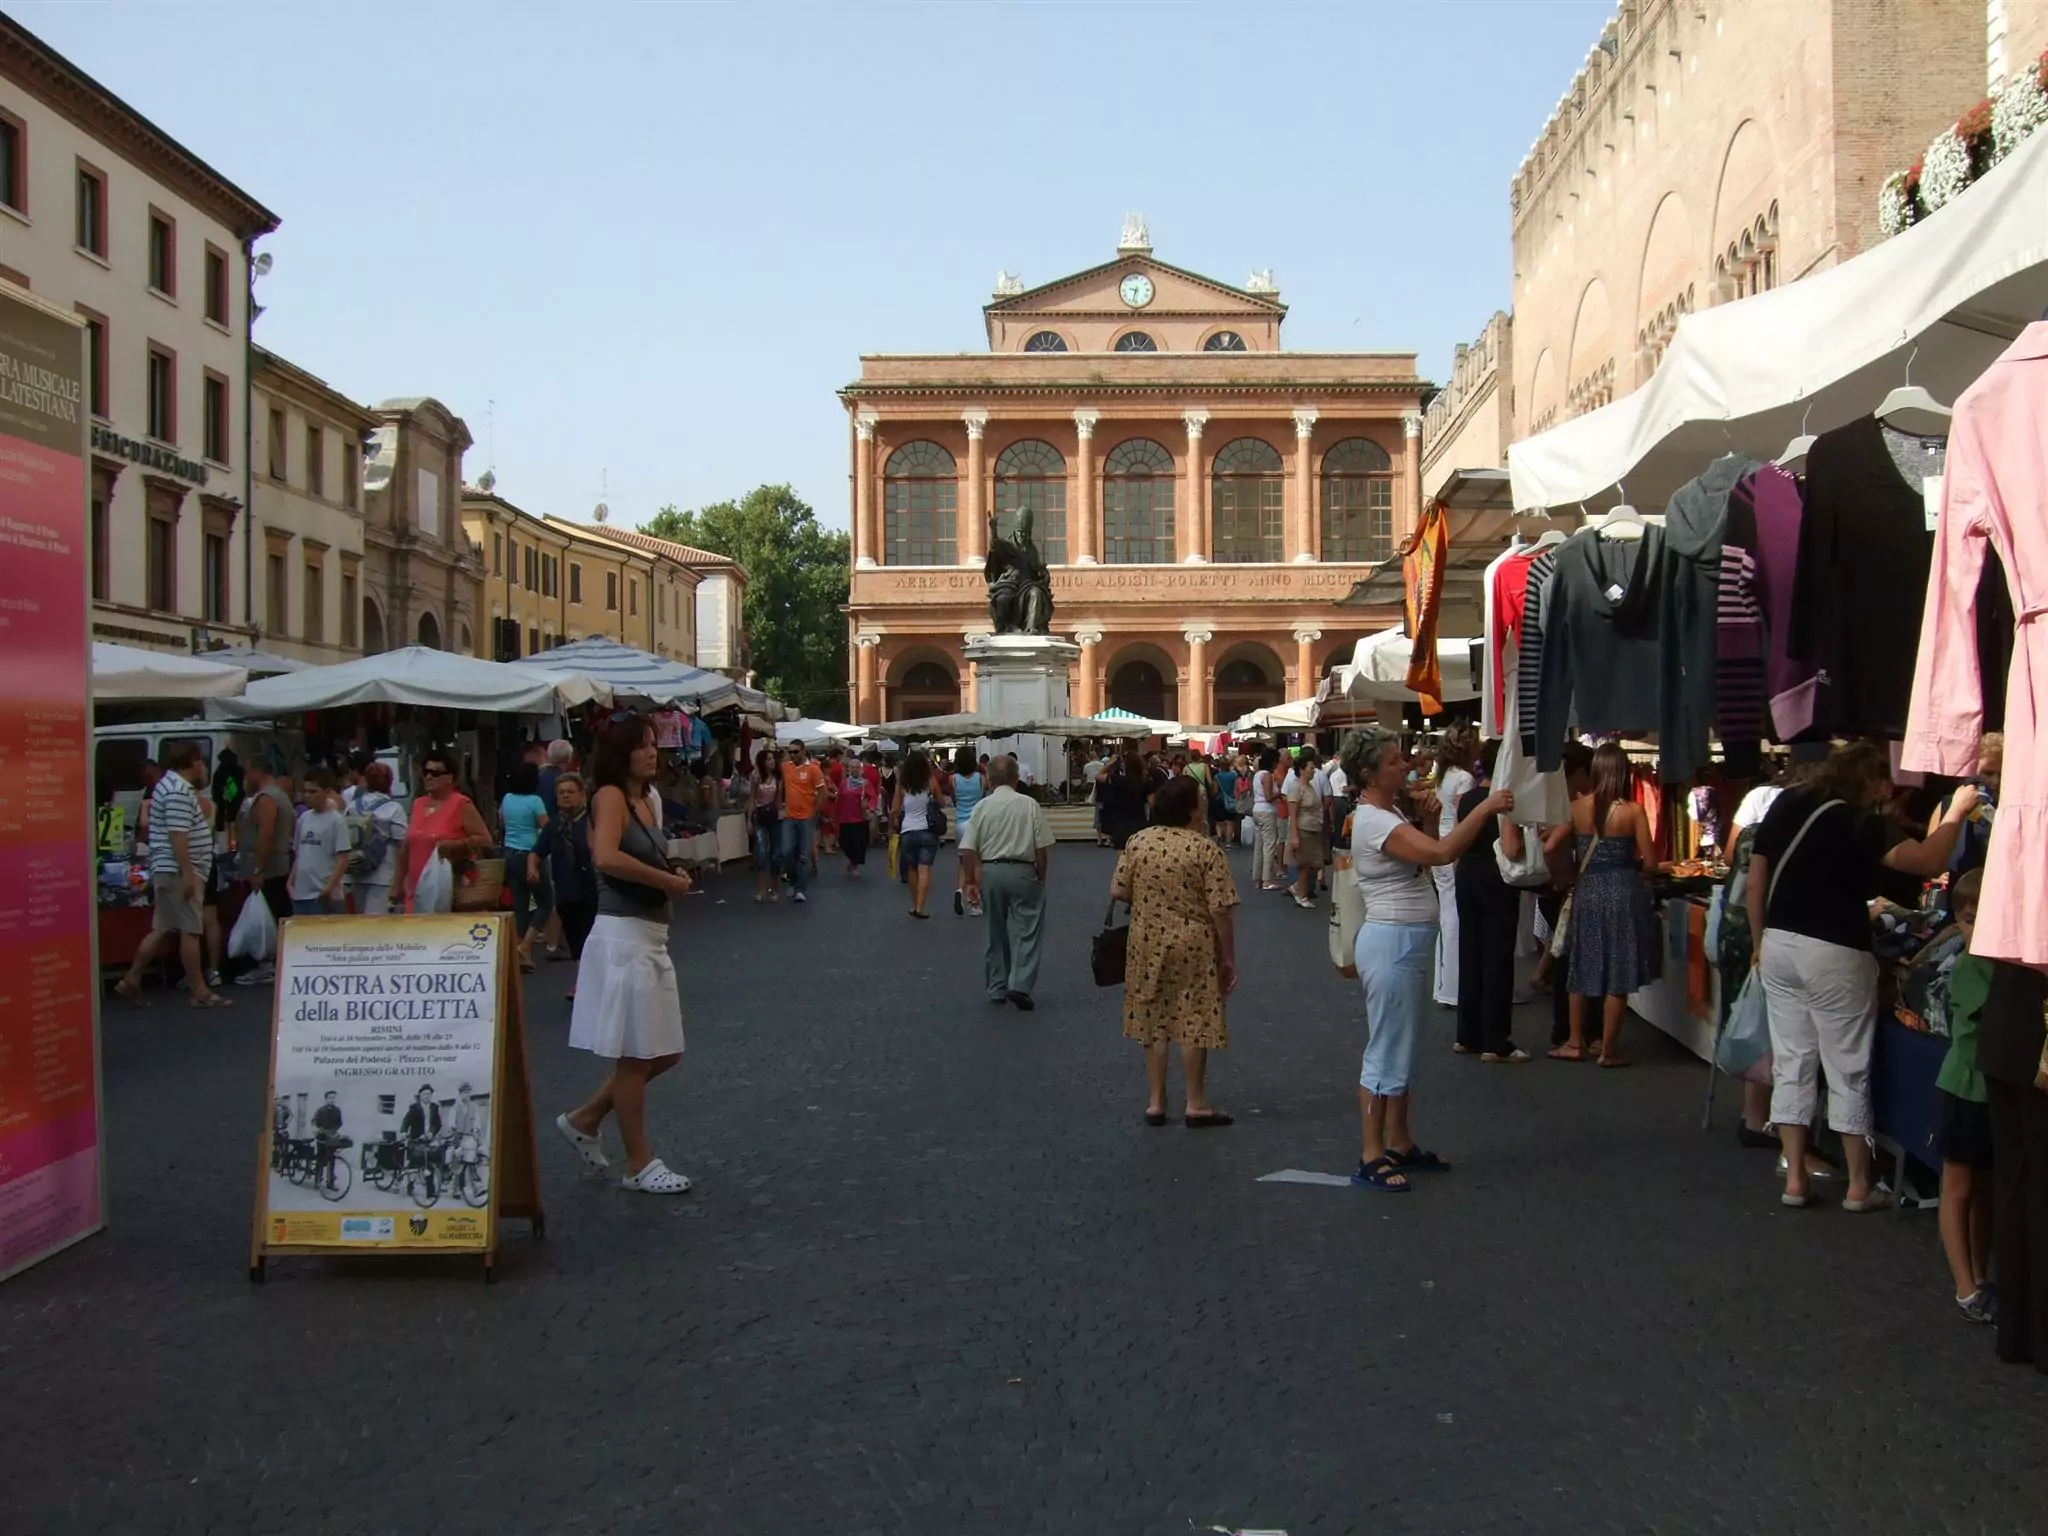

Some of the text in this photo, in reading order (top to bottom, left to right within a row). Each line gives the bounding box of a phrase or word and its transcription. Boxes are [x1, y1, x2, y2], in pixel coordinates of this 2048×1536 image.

[23, 362, 80, 403] MUSICALE
[897, 575, 937, 588] AERE
[1051, 575, 1083, 588] NIO
[1168, 575, 1236, 587] POLETTI
[1250, 574, 1291, 587] ANNO
[1304, 574, 1362, 587] MDCCC
[290, 973, 486, 995] MOSTRA STORICA
[295, 999, 480, 1021] della BICICLETTA
[370, 1025, 402, 1034] RIMINI
[313, 1055, 344, 1064] Palazzo
[399, 1054, 425, 1063] Piazza
[426, 1053, 458, 1062] Cavour
[334, 1067, 435, 1077] INGRESSO GRATUITO
